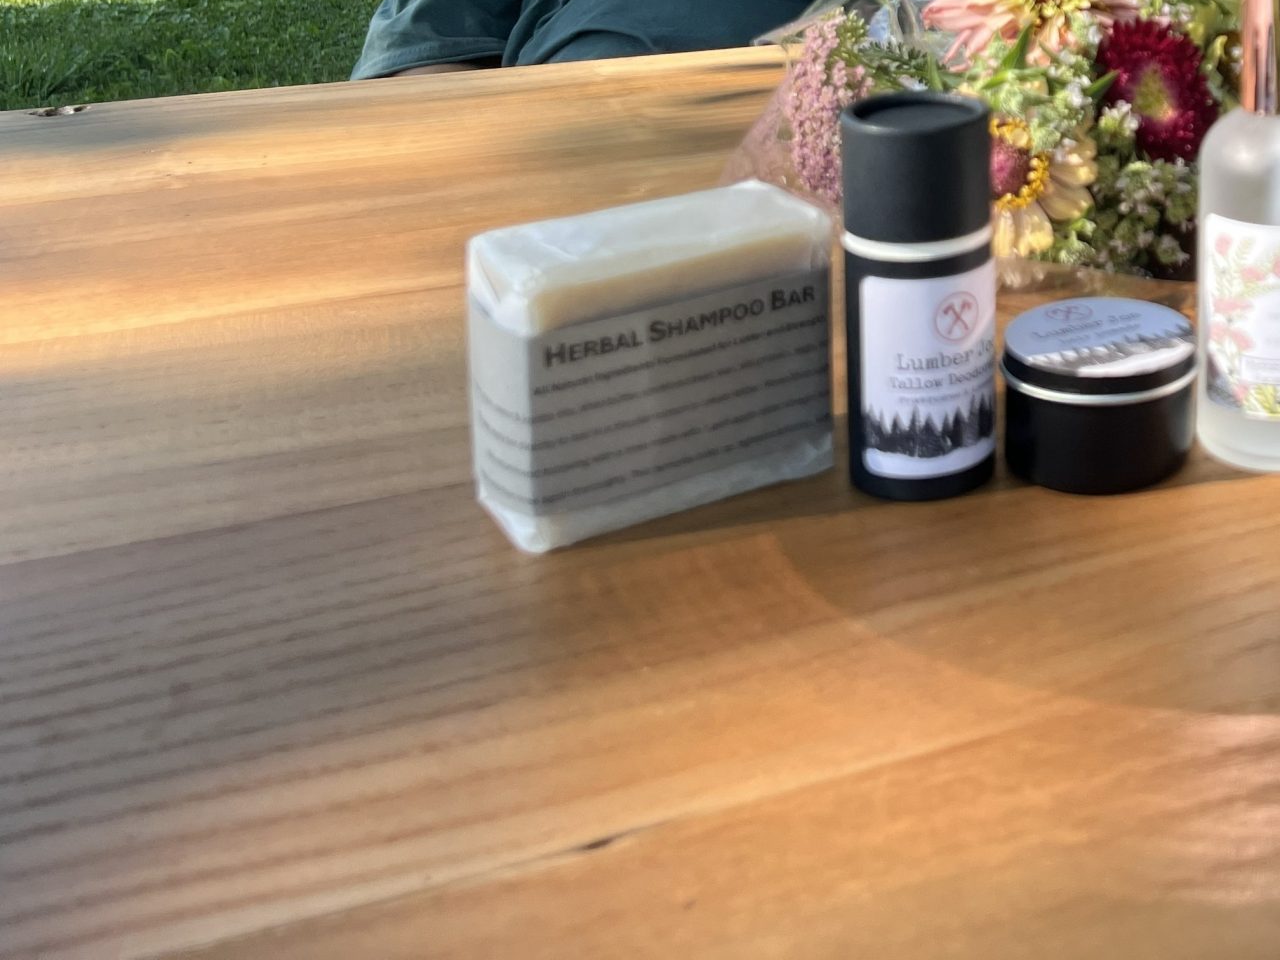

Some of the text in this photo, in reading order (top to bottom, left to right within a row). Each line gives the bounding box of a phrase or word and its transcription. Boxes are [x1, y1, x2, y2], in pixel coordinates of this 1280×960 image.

[544, 330, 644, 367] HERBAL
[648, 298, 765, 342] SHAMPOO
[770, 286, 815, 311] BAR
[896, 350, 974, 370] Lumber
[889, 376, 943, 389] Tallow
